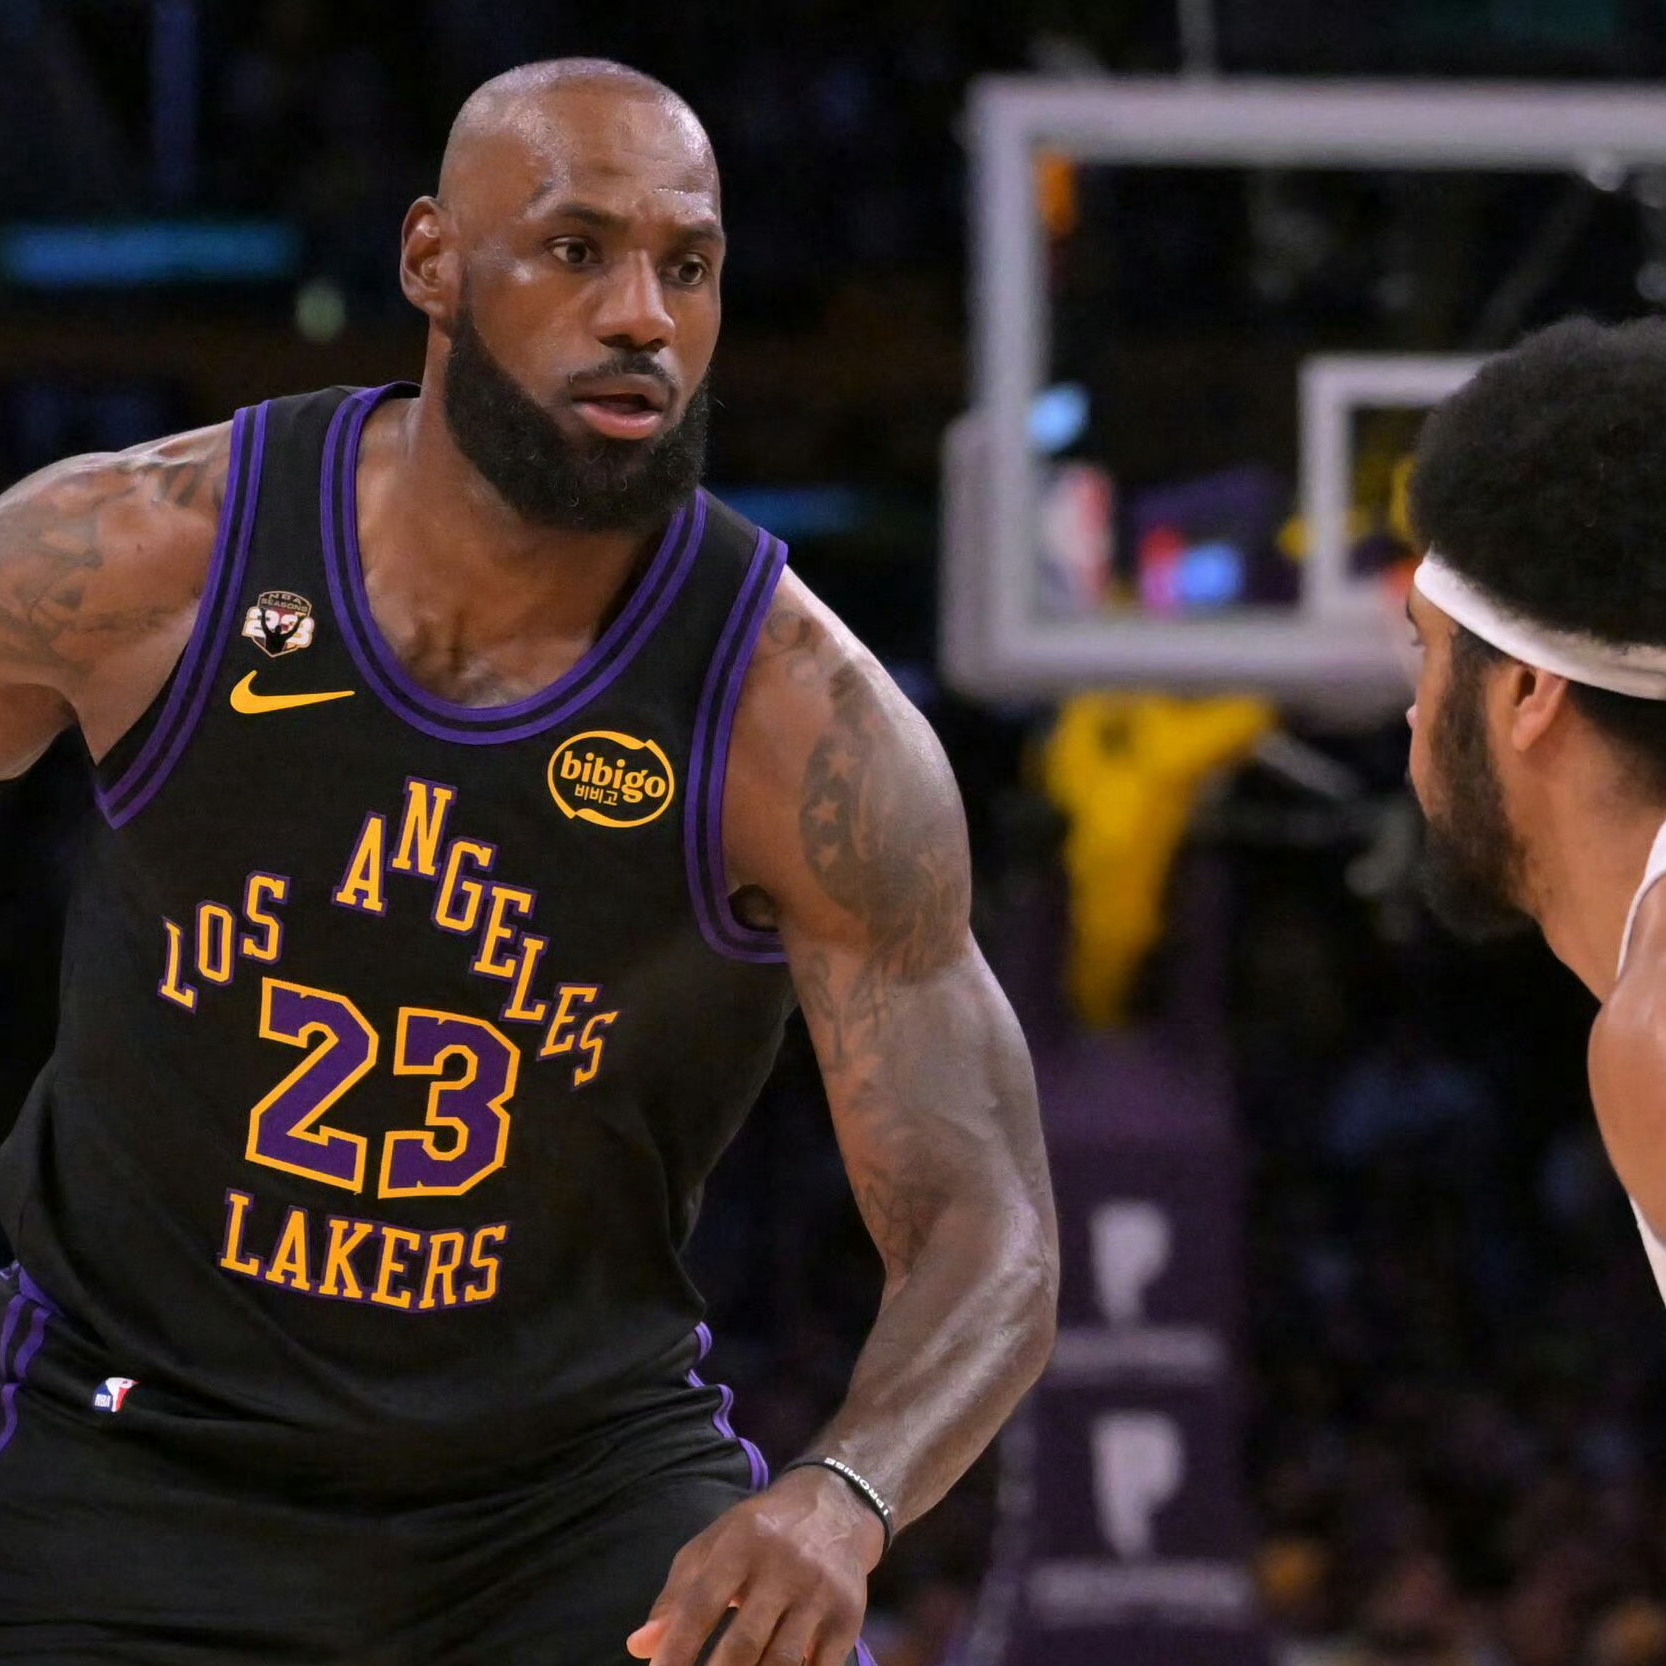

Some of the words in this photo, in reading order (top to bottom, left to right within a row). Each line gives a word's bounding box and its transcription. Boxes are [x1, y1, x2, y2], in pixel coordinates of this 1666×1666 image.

[260, 597, 309, 613] SEASONS
[269, 593, 302, 605] NBA
[560, 750, 666, 804] bibigo
[574, 783, 618, 806] 비비고
[158, 869, 291, 1013] LOS
[332, 776, 619, 1091] ANGELES
[245, 976, 521, 1199] 23
[218, 1187, 511, 1311] LAKERS
